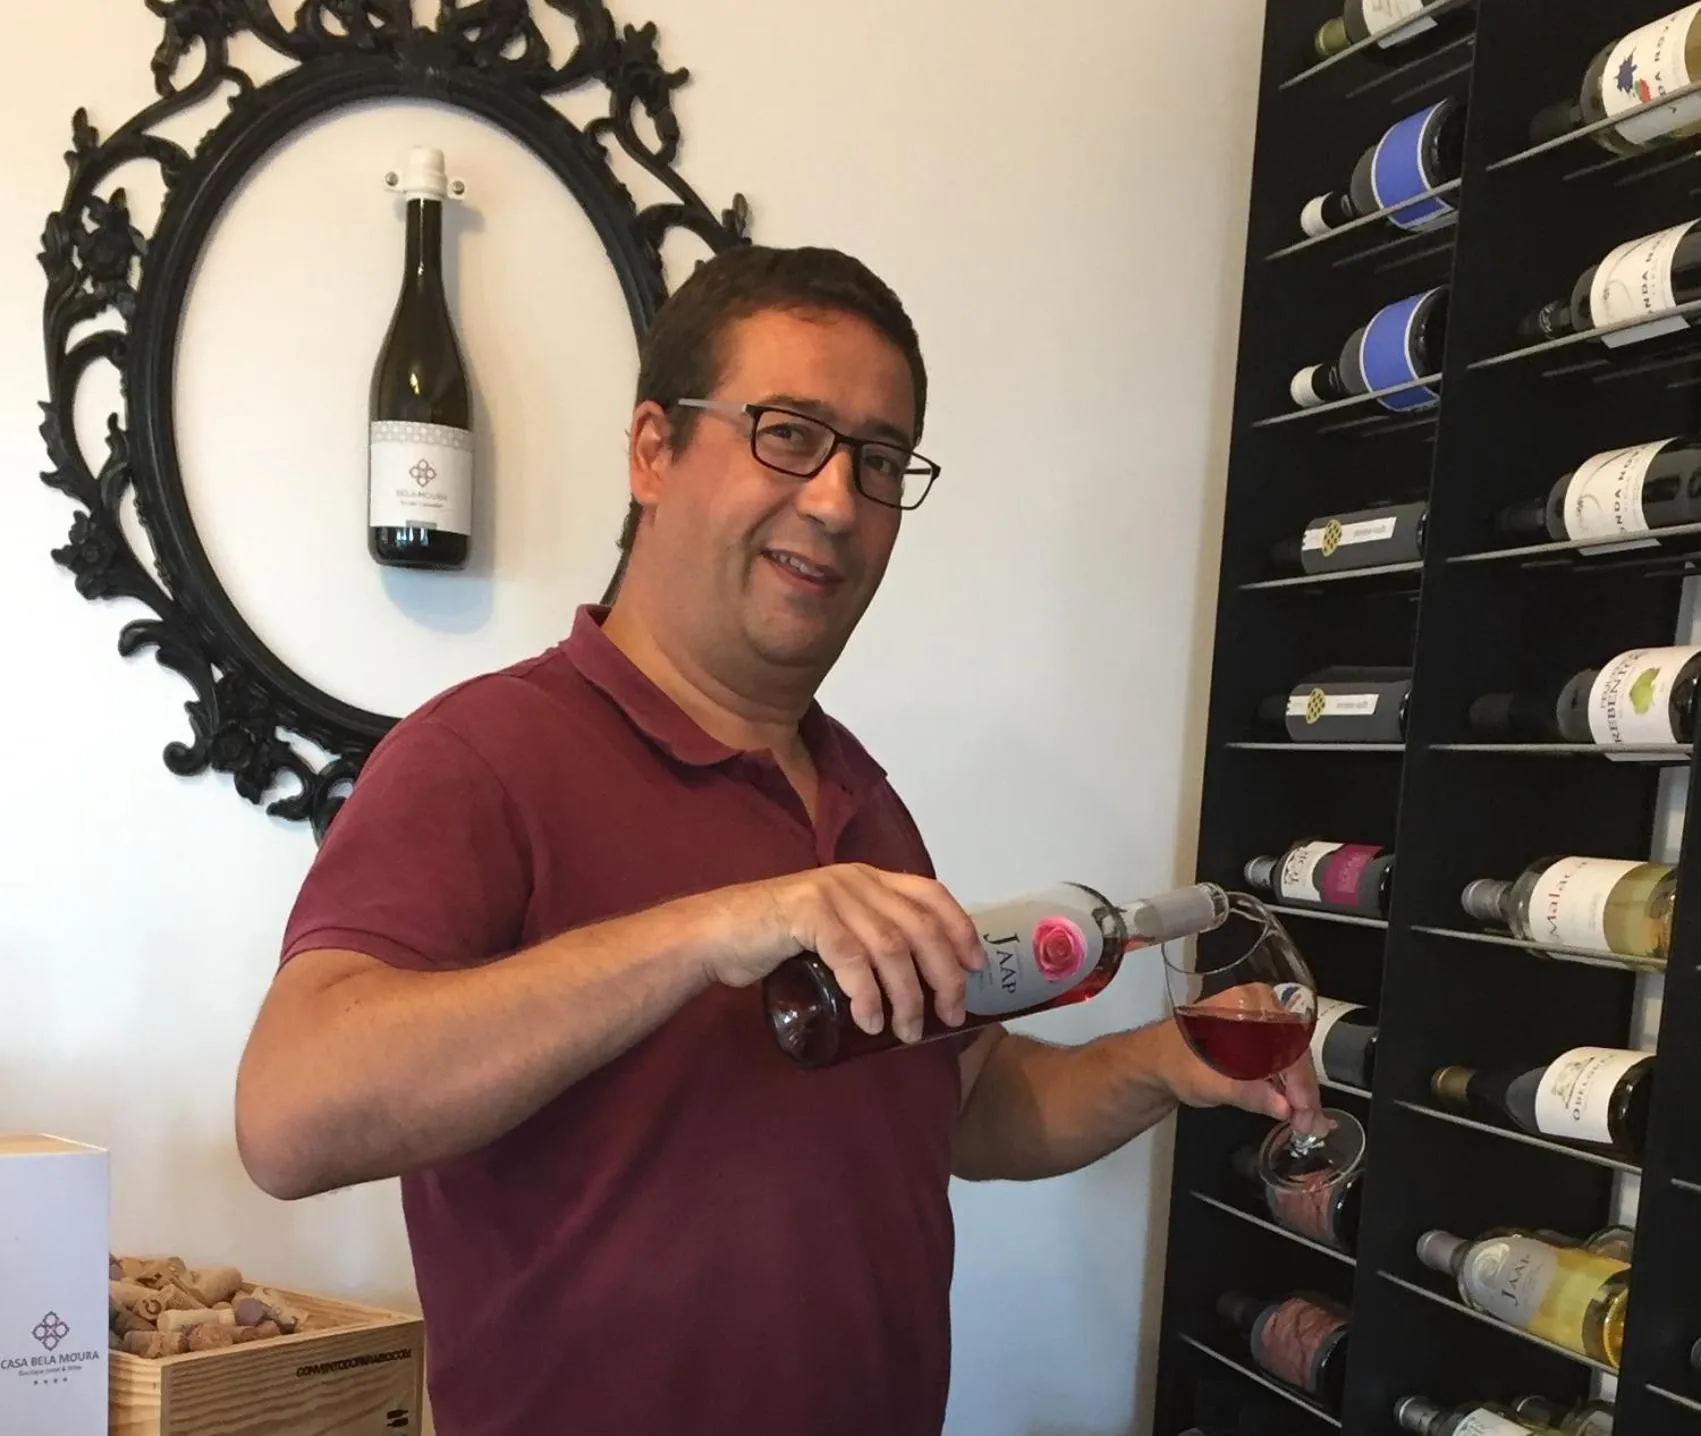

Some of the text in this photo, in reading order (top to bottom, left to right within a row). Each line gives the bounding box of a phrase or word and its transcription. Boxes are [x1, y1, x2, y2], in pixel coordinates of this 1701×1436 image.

[983, 932, 1020, 994] JAAP
[0, 1350, 101, 1370] CASA BELA MOURA
